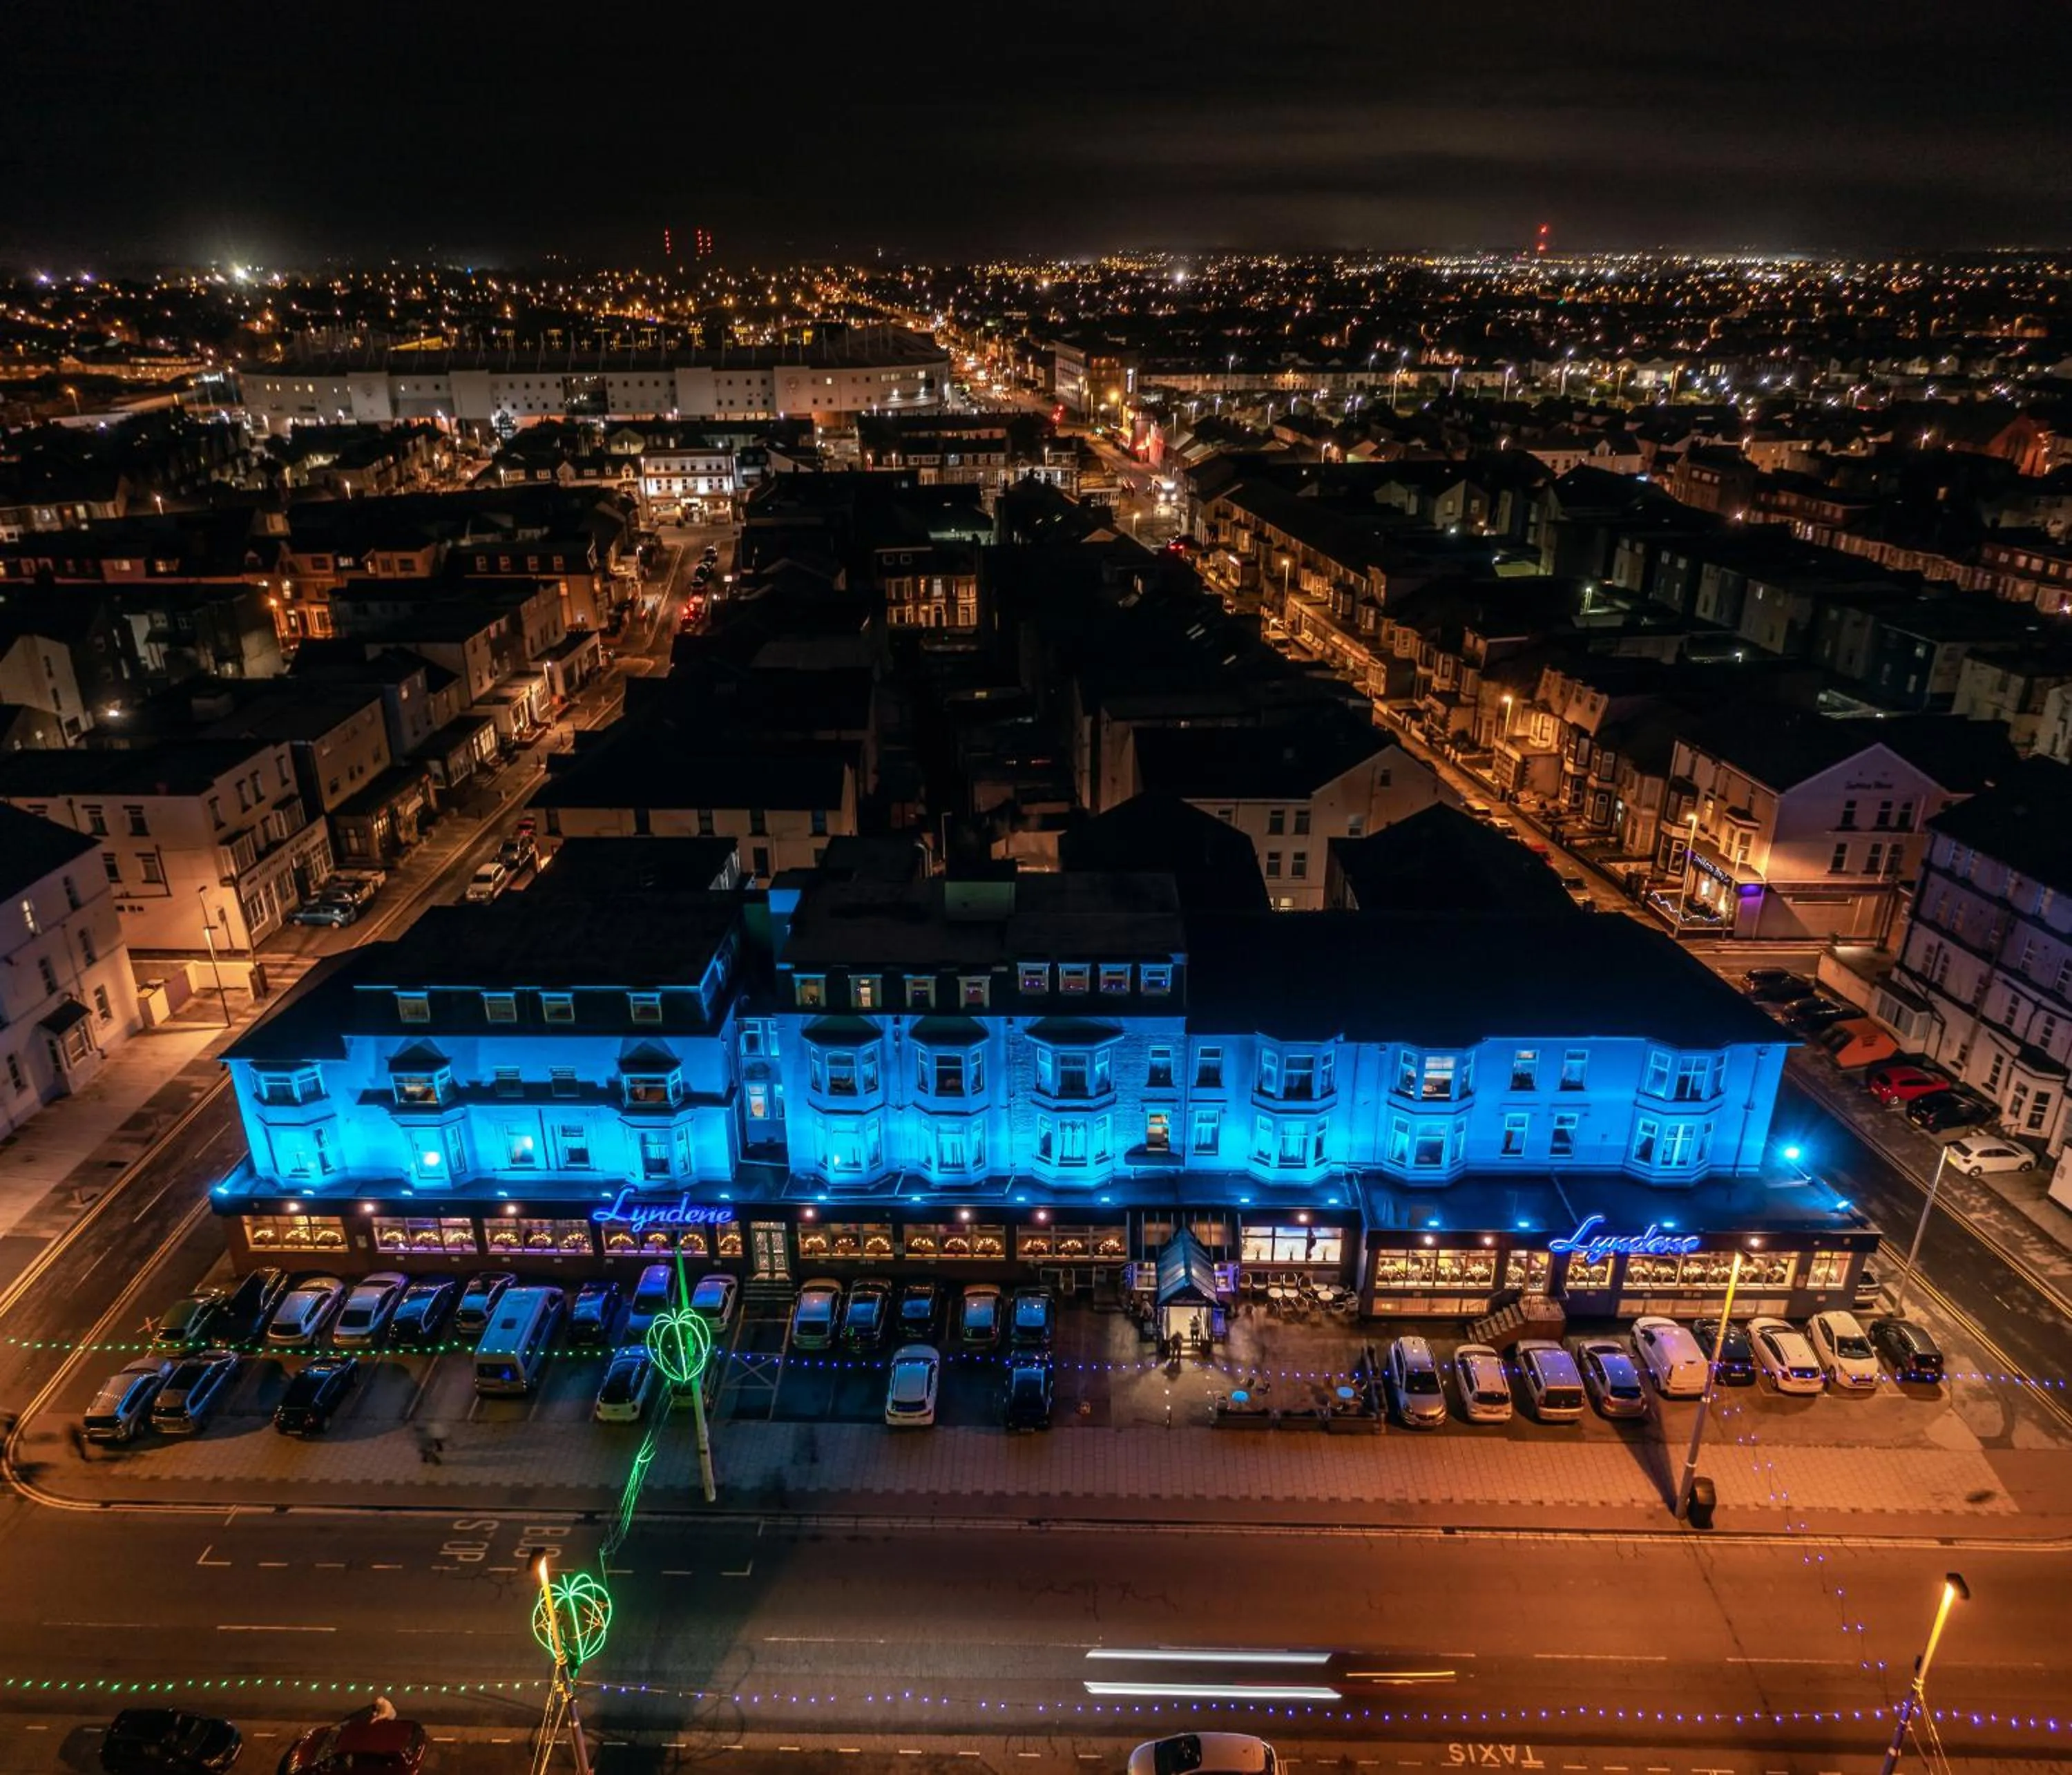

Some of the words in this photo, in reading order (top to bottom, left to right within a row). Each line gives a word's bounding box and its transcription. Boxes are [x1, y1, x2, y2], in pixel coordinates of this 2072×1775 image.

[593, 1187, 732, 1232] Lyndene
[1549, 1214, 1700, 1263] Lyndene
[440, 1519, 499, 1562] SOP
[1448, 1743, 1544, 1765] TAXIS
